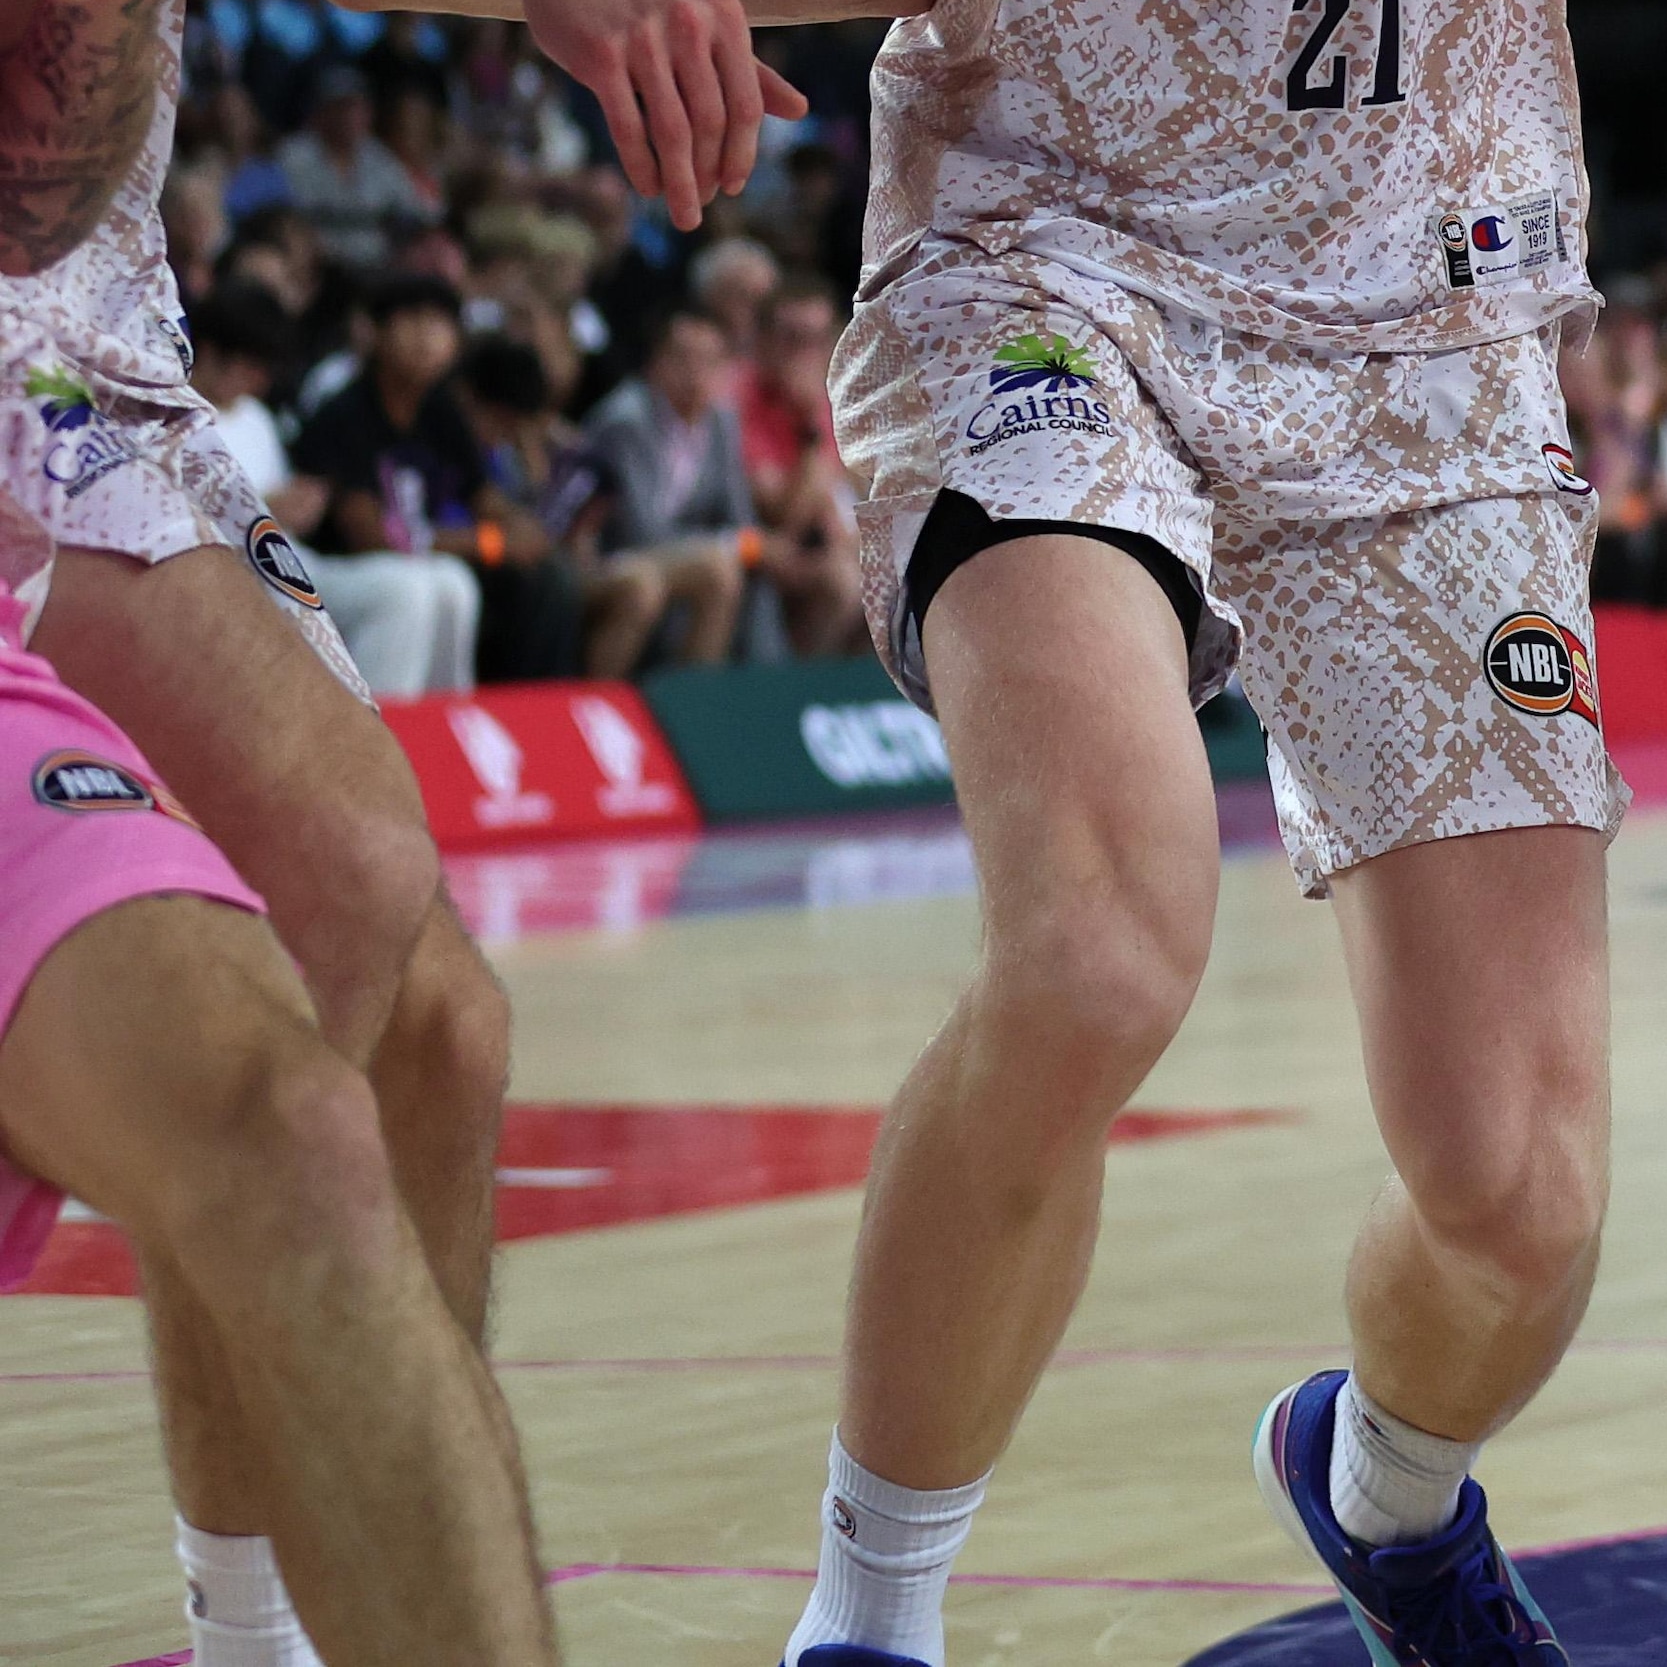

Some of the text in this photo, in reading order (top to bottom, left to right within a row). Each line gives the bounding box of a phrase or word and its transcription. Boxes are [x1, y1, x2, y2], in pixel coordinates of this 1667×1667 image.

[1521, 214, 1550, 234] SINCE
[1527, 232, 1548, 249] 1919
[966, 395, 1111, 440] Cairns
[969, 419, 1114, 457] REGIONAL COUNCIL
[1508, 643, 1564, 686] NBL
[56, 767, 136, 800] NBL
